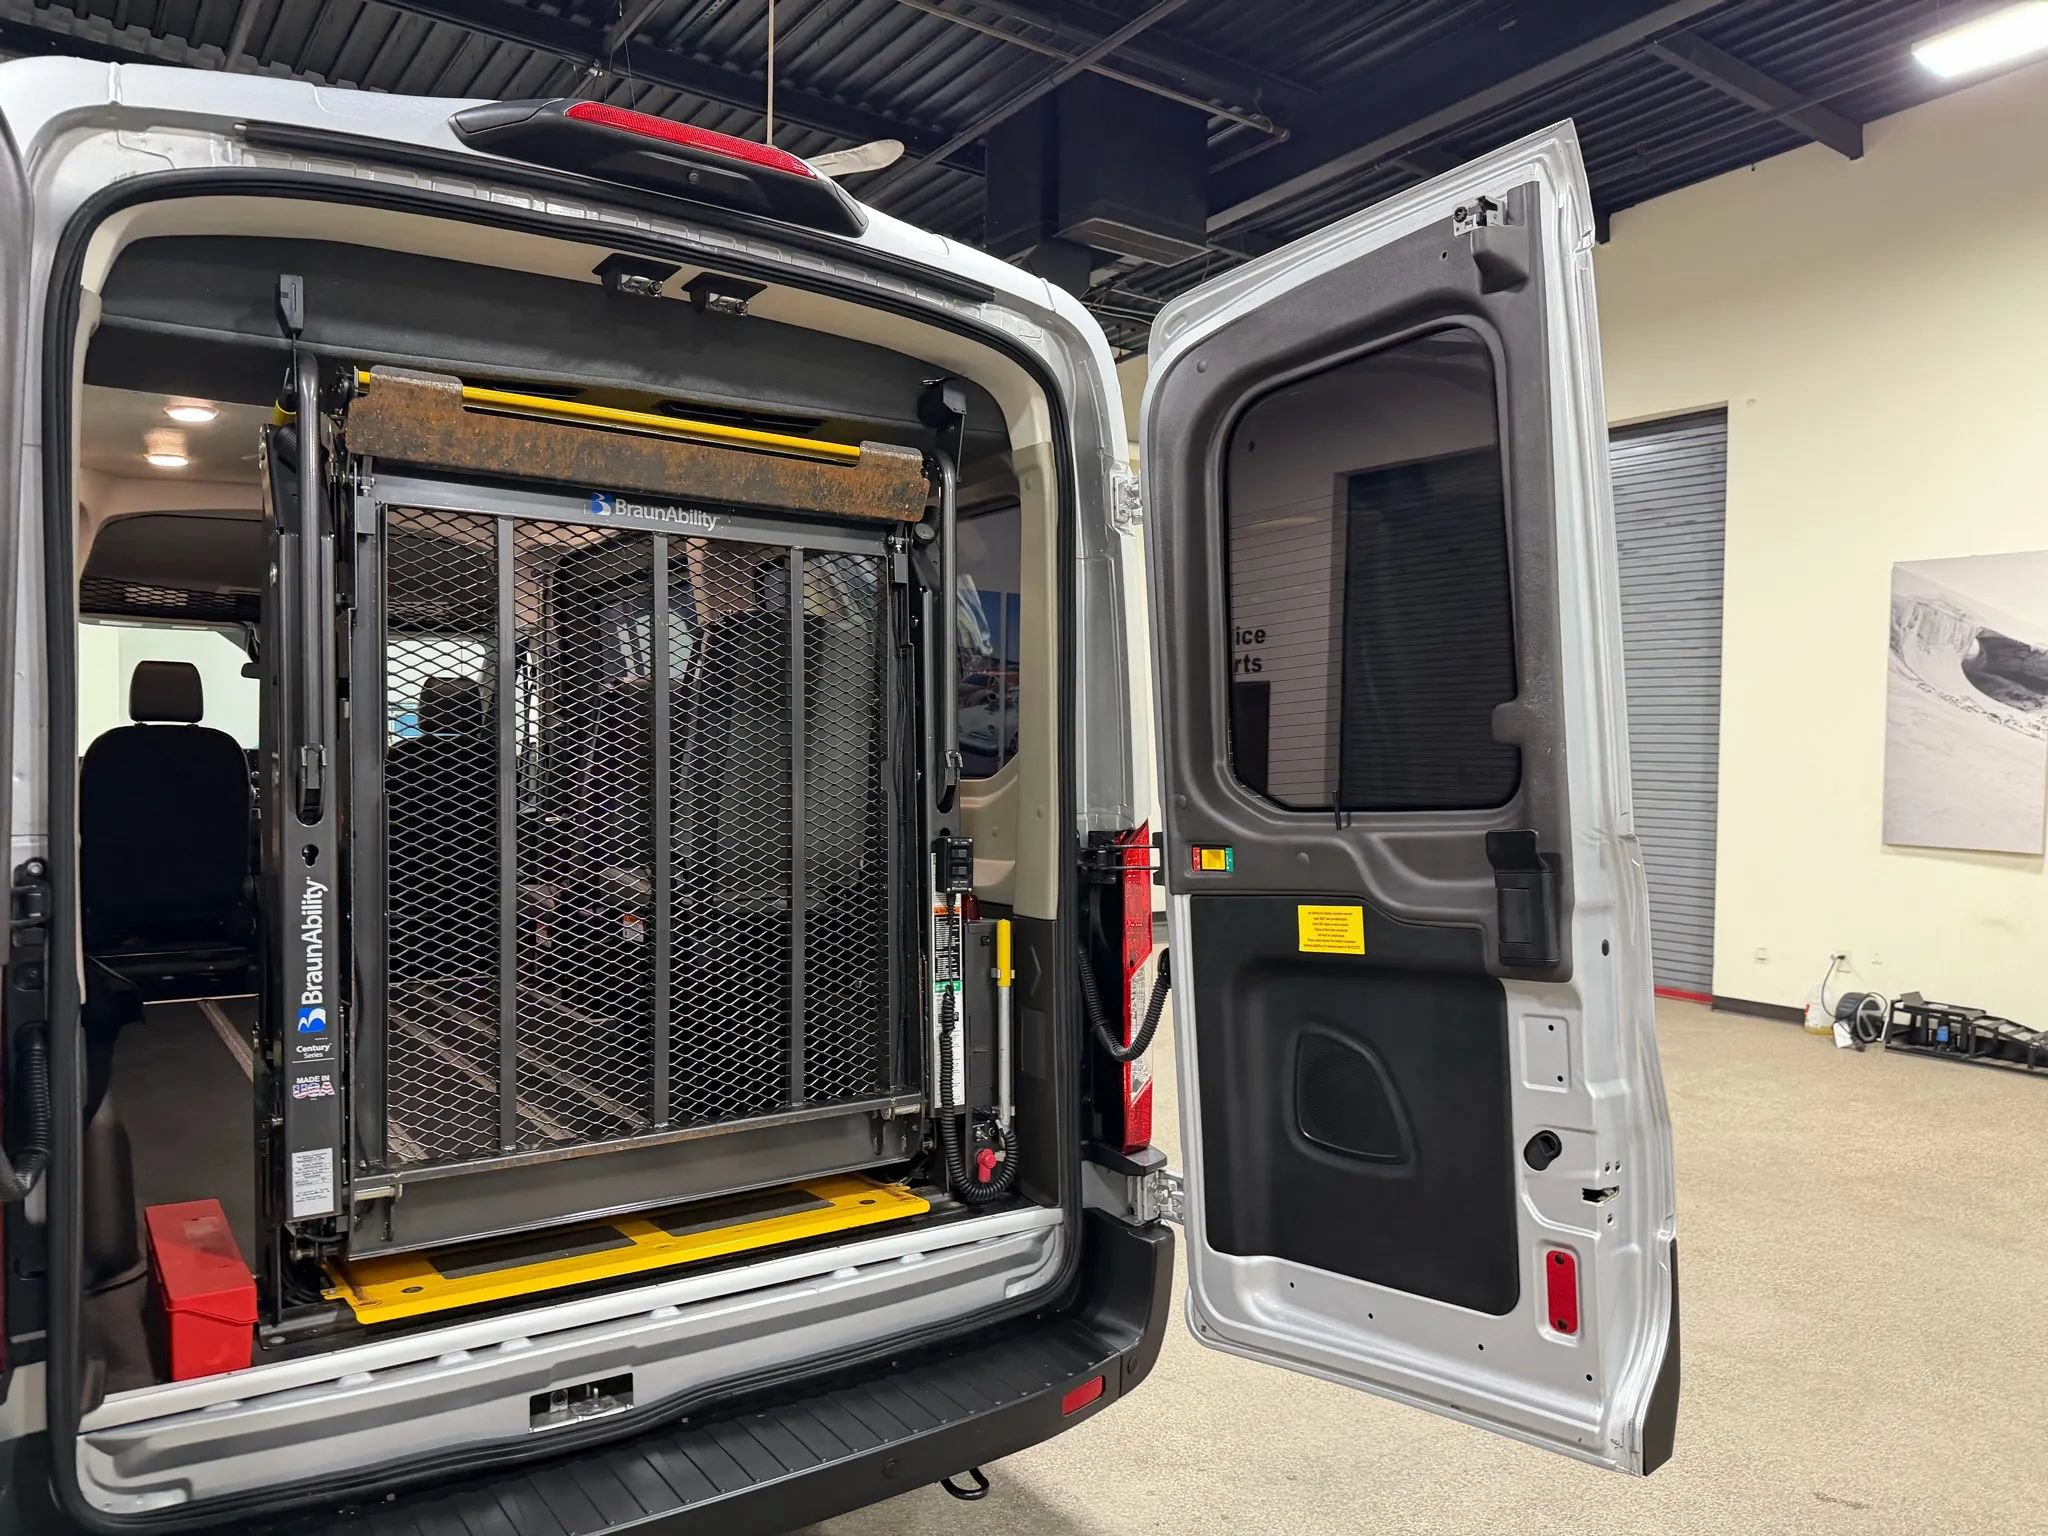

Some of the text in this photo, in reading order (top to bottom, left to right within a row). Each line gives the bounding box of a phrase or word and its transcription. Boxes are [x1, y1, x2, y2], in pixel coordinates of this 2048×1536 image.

[615, 498, 718, 532] BraunAbility
[301, 878, 329, 1005] BraunAbility
[296, 1044, 331, 1053] Century
[296, 1074, 330, 1084] MADE IN
[292, 1081, 336, 1099] USA
